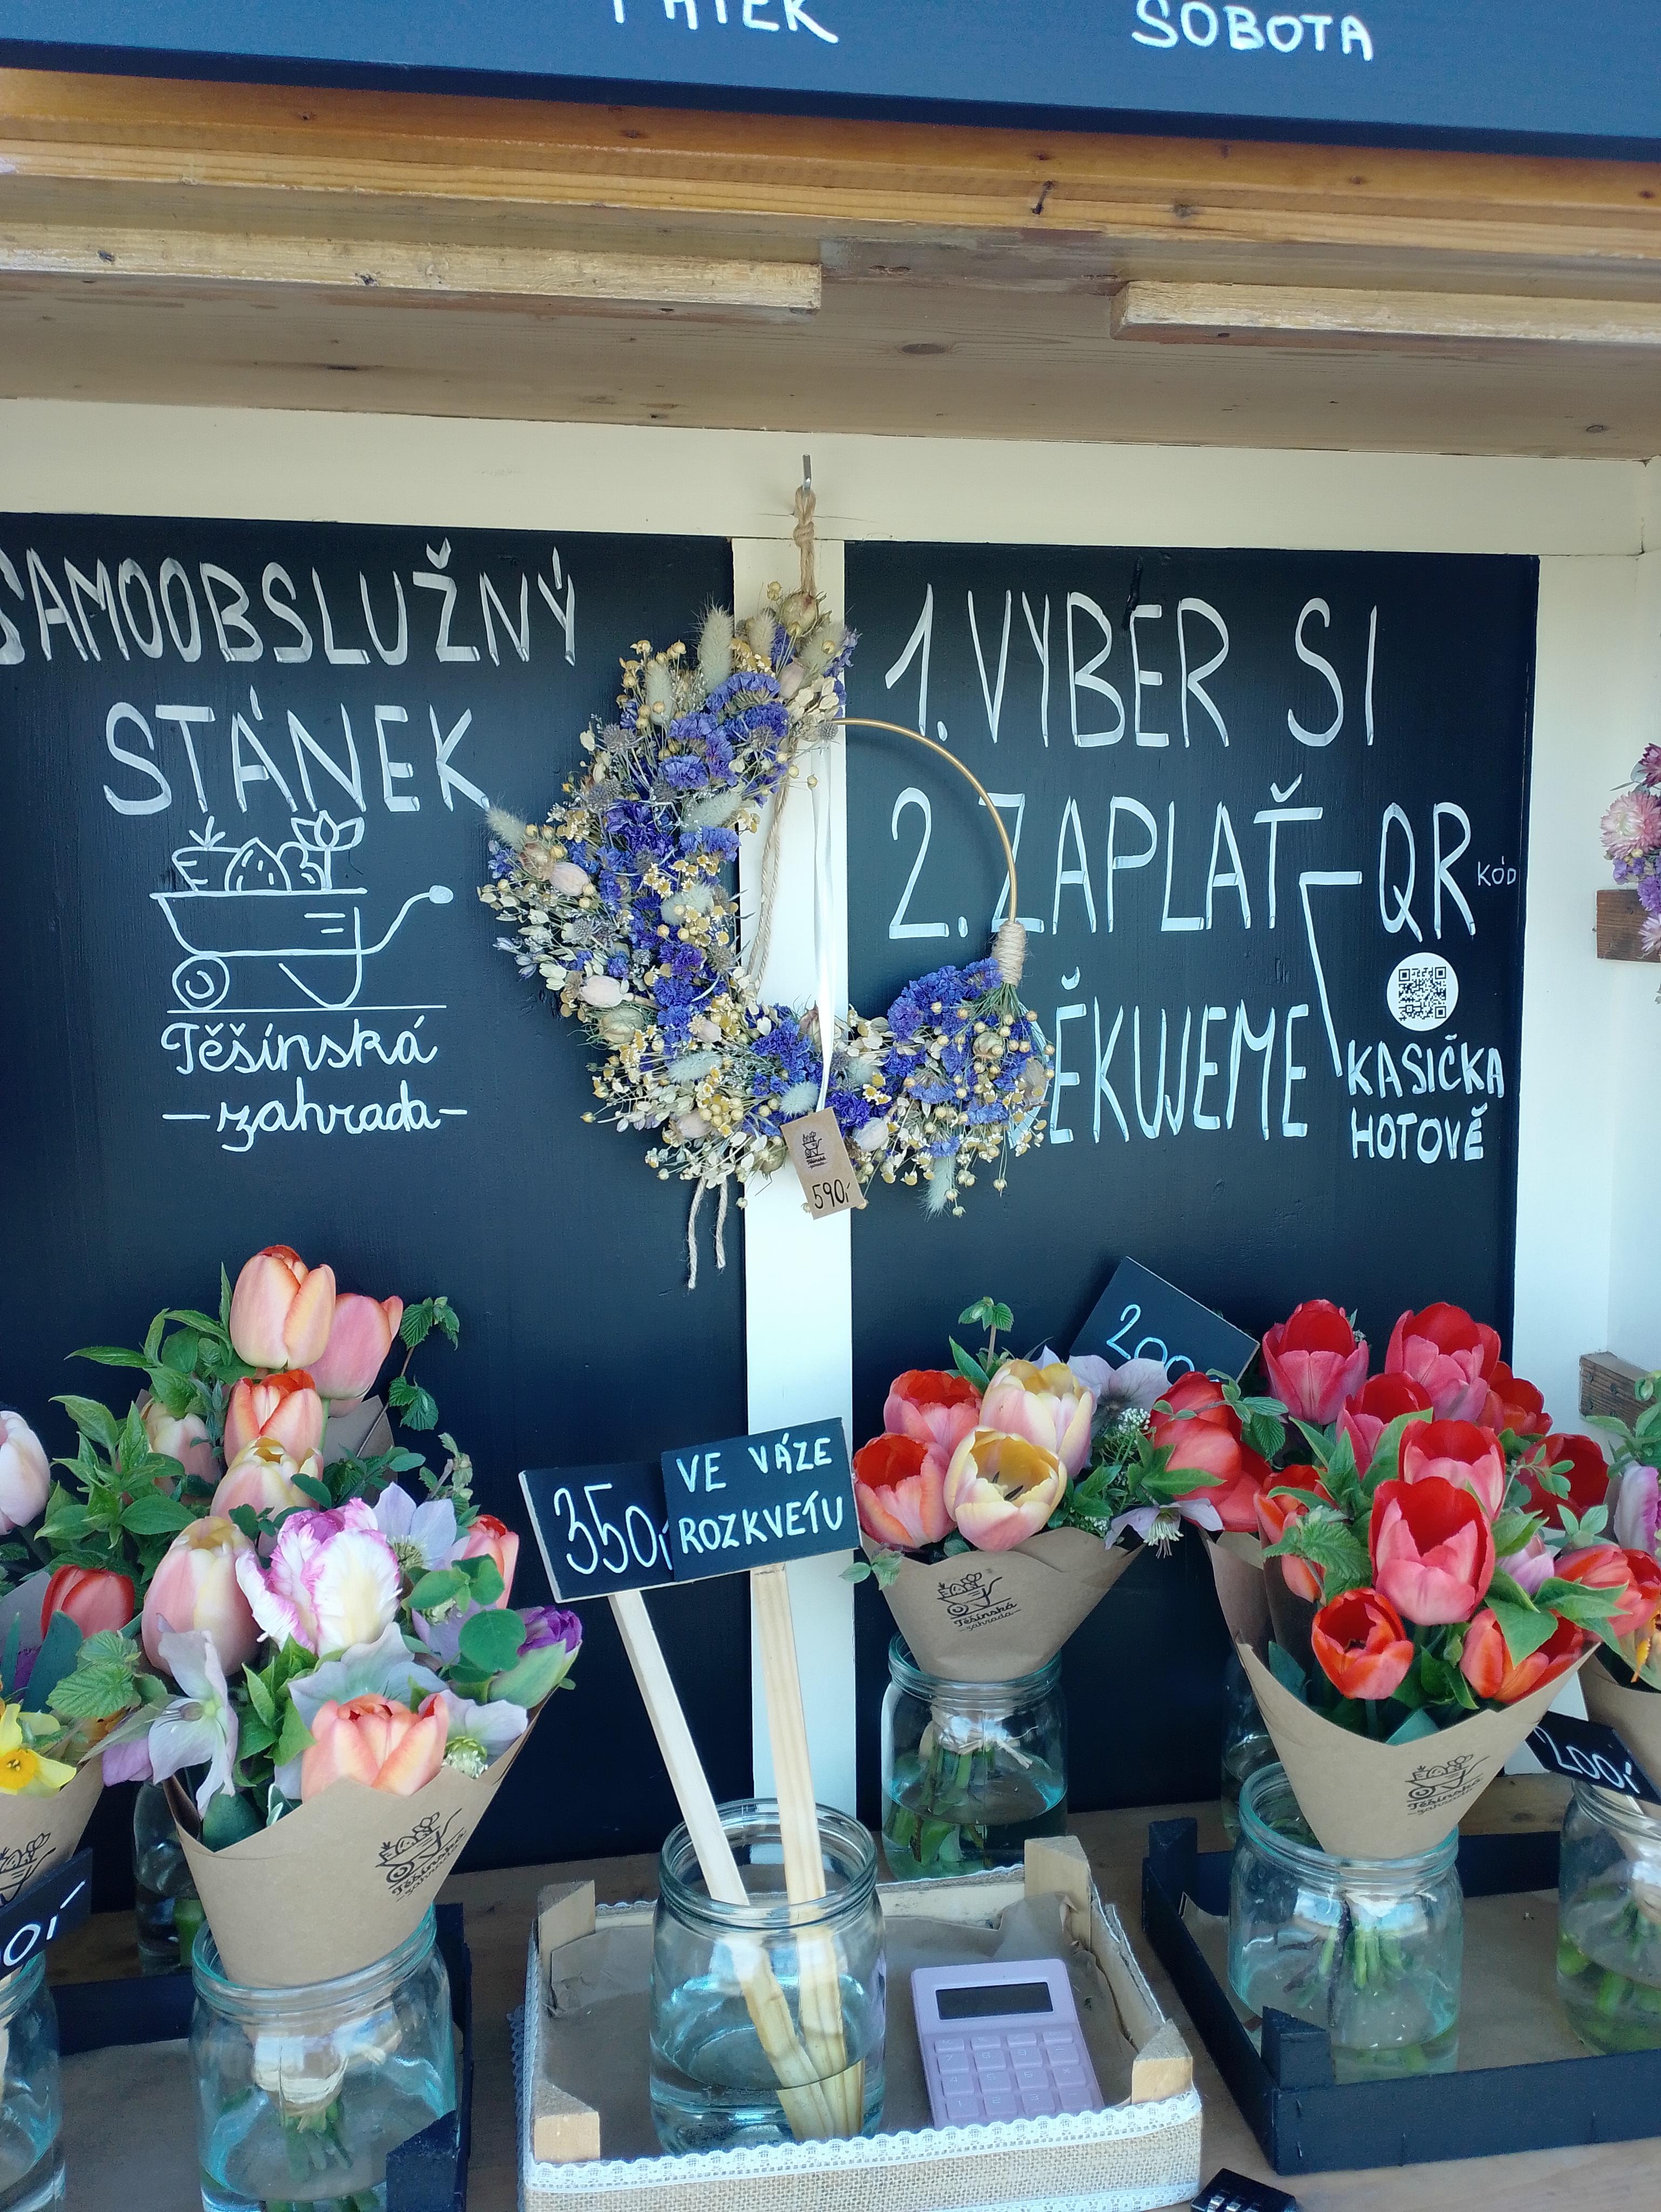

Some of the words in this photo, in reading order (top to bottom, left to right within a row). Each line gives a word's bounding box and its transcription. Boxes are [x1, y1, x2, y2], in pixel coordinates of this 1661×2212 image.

[1131, 0, 1373, 61] SOBOTA
[1288, 597, 1377, 747] SI
[103, 685, 490, 815] STÁNEK
[1379, 802, 1476, 943] QR
[1477, 855, 1516, 887] KÓD
[160, 1015, 438, 1075] Těšínská
[1348, 1033, 1504, 1099] KASIČKA
[216, 1076, 442, 1152] zahrada
[1351, 1102, 1488, 1164] HOTOVĚ
[676, 1452, 726, 1493] VE
[748, 1432, 833, 1474] VÁZE
